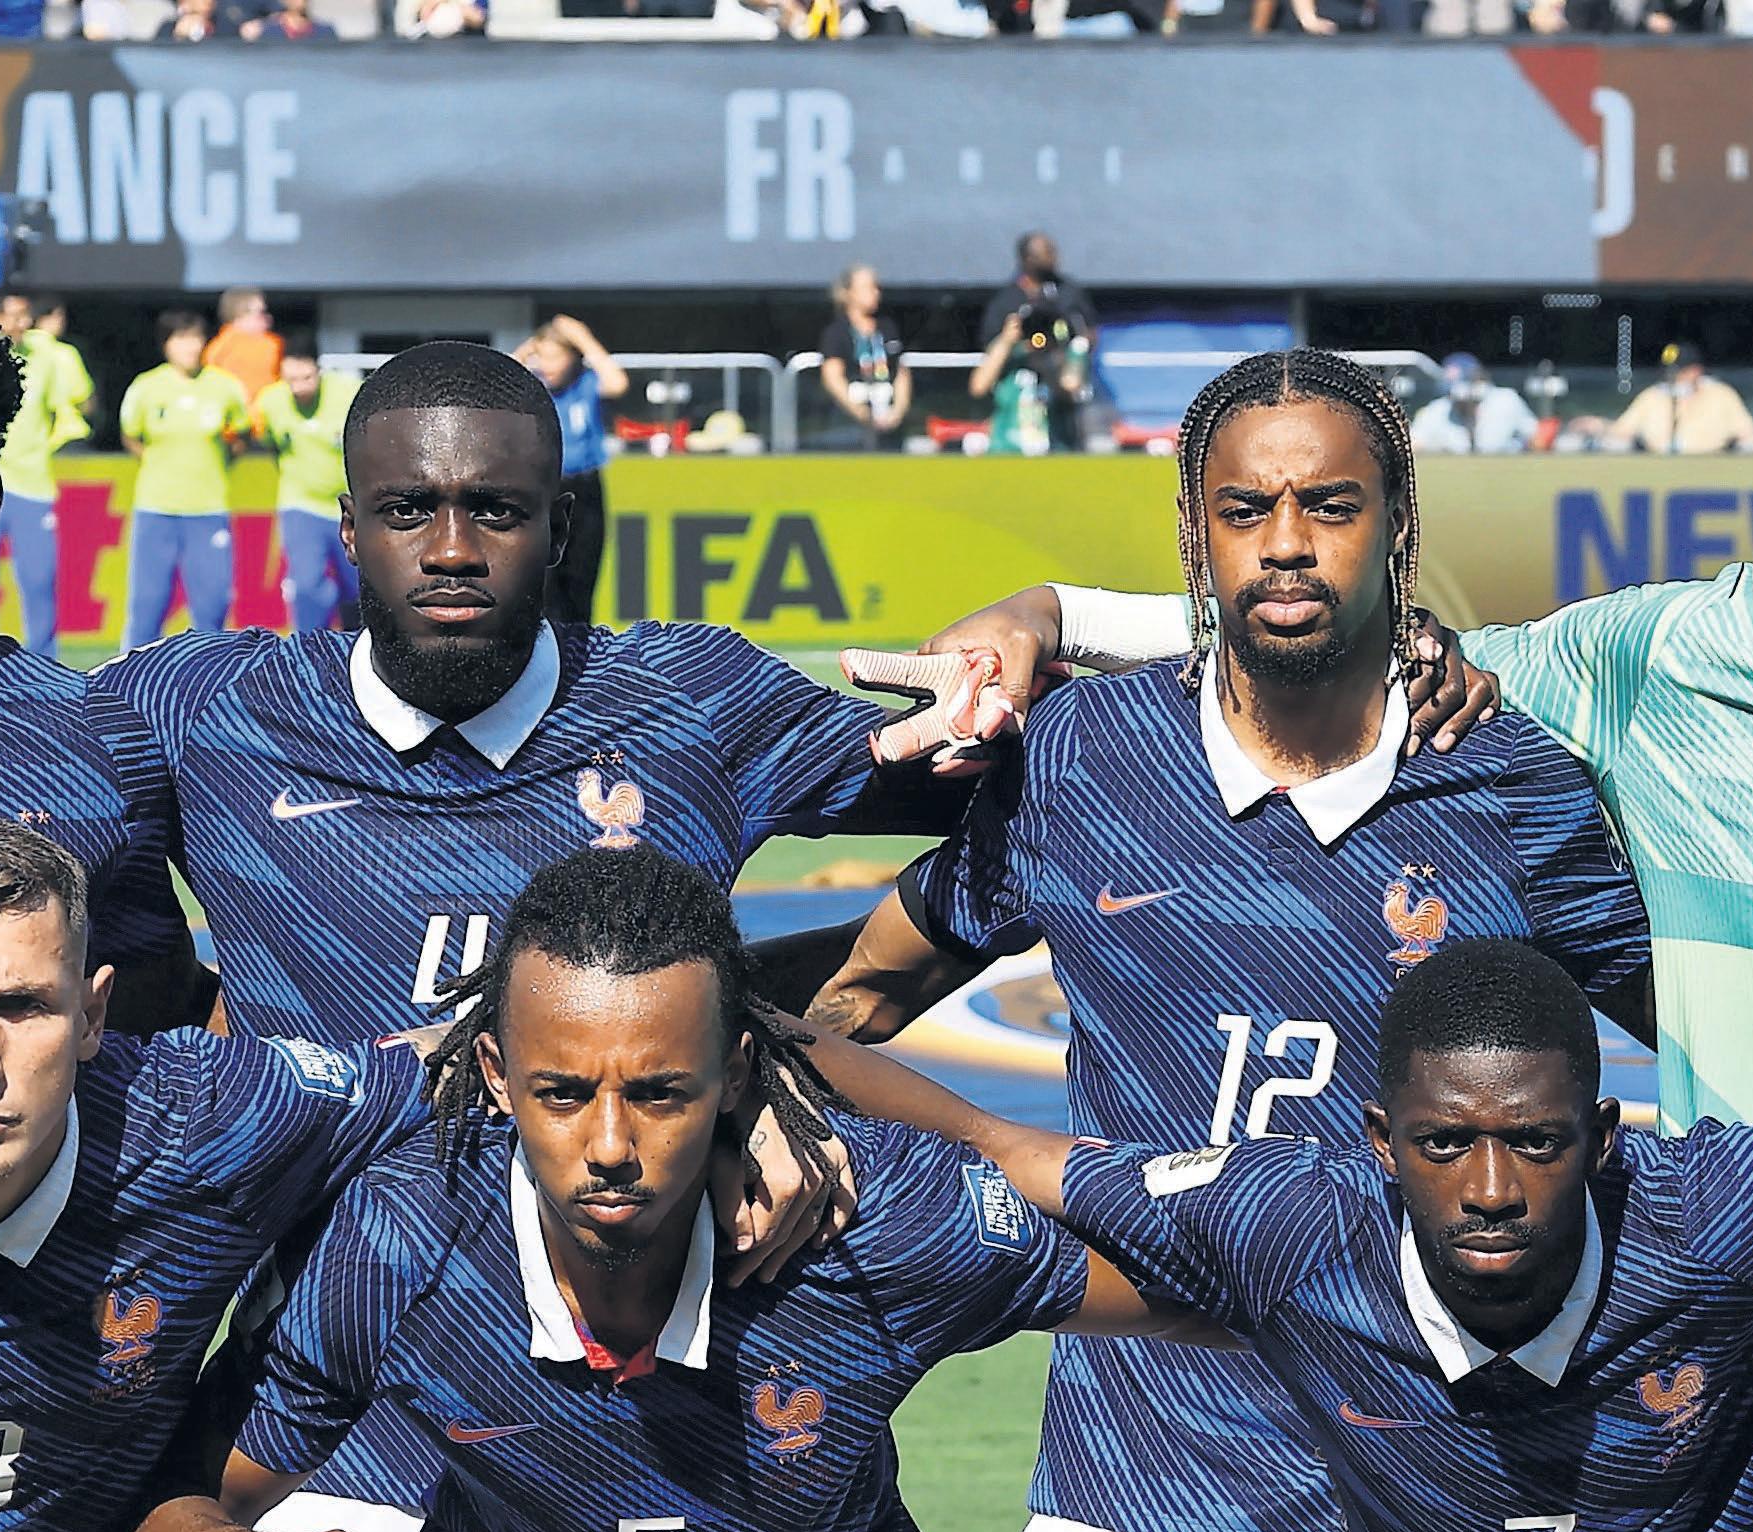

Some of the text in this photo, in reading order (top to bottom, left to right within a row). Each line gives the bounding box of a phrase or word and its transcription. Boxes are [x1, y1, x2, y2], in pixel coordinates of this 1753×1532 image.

[726, 88, 856, 242] FR
[614, 513, 850, 624] IFA
[1210, 1014, 1339, 1147] 12
